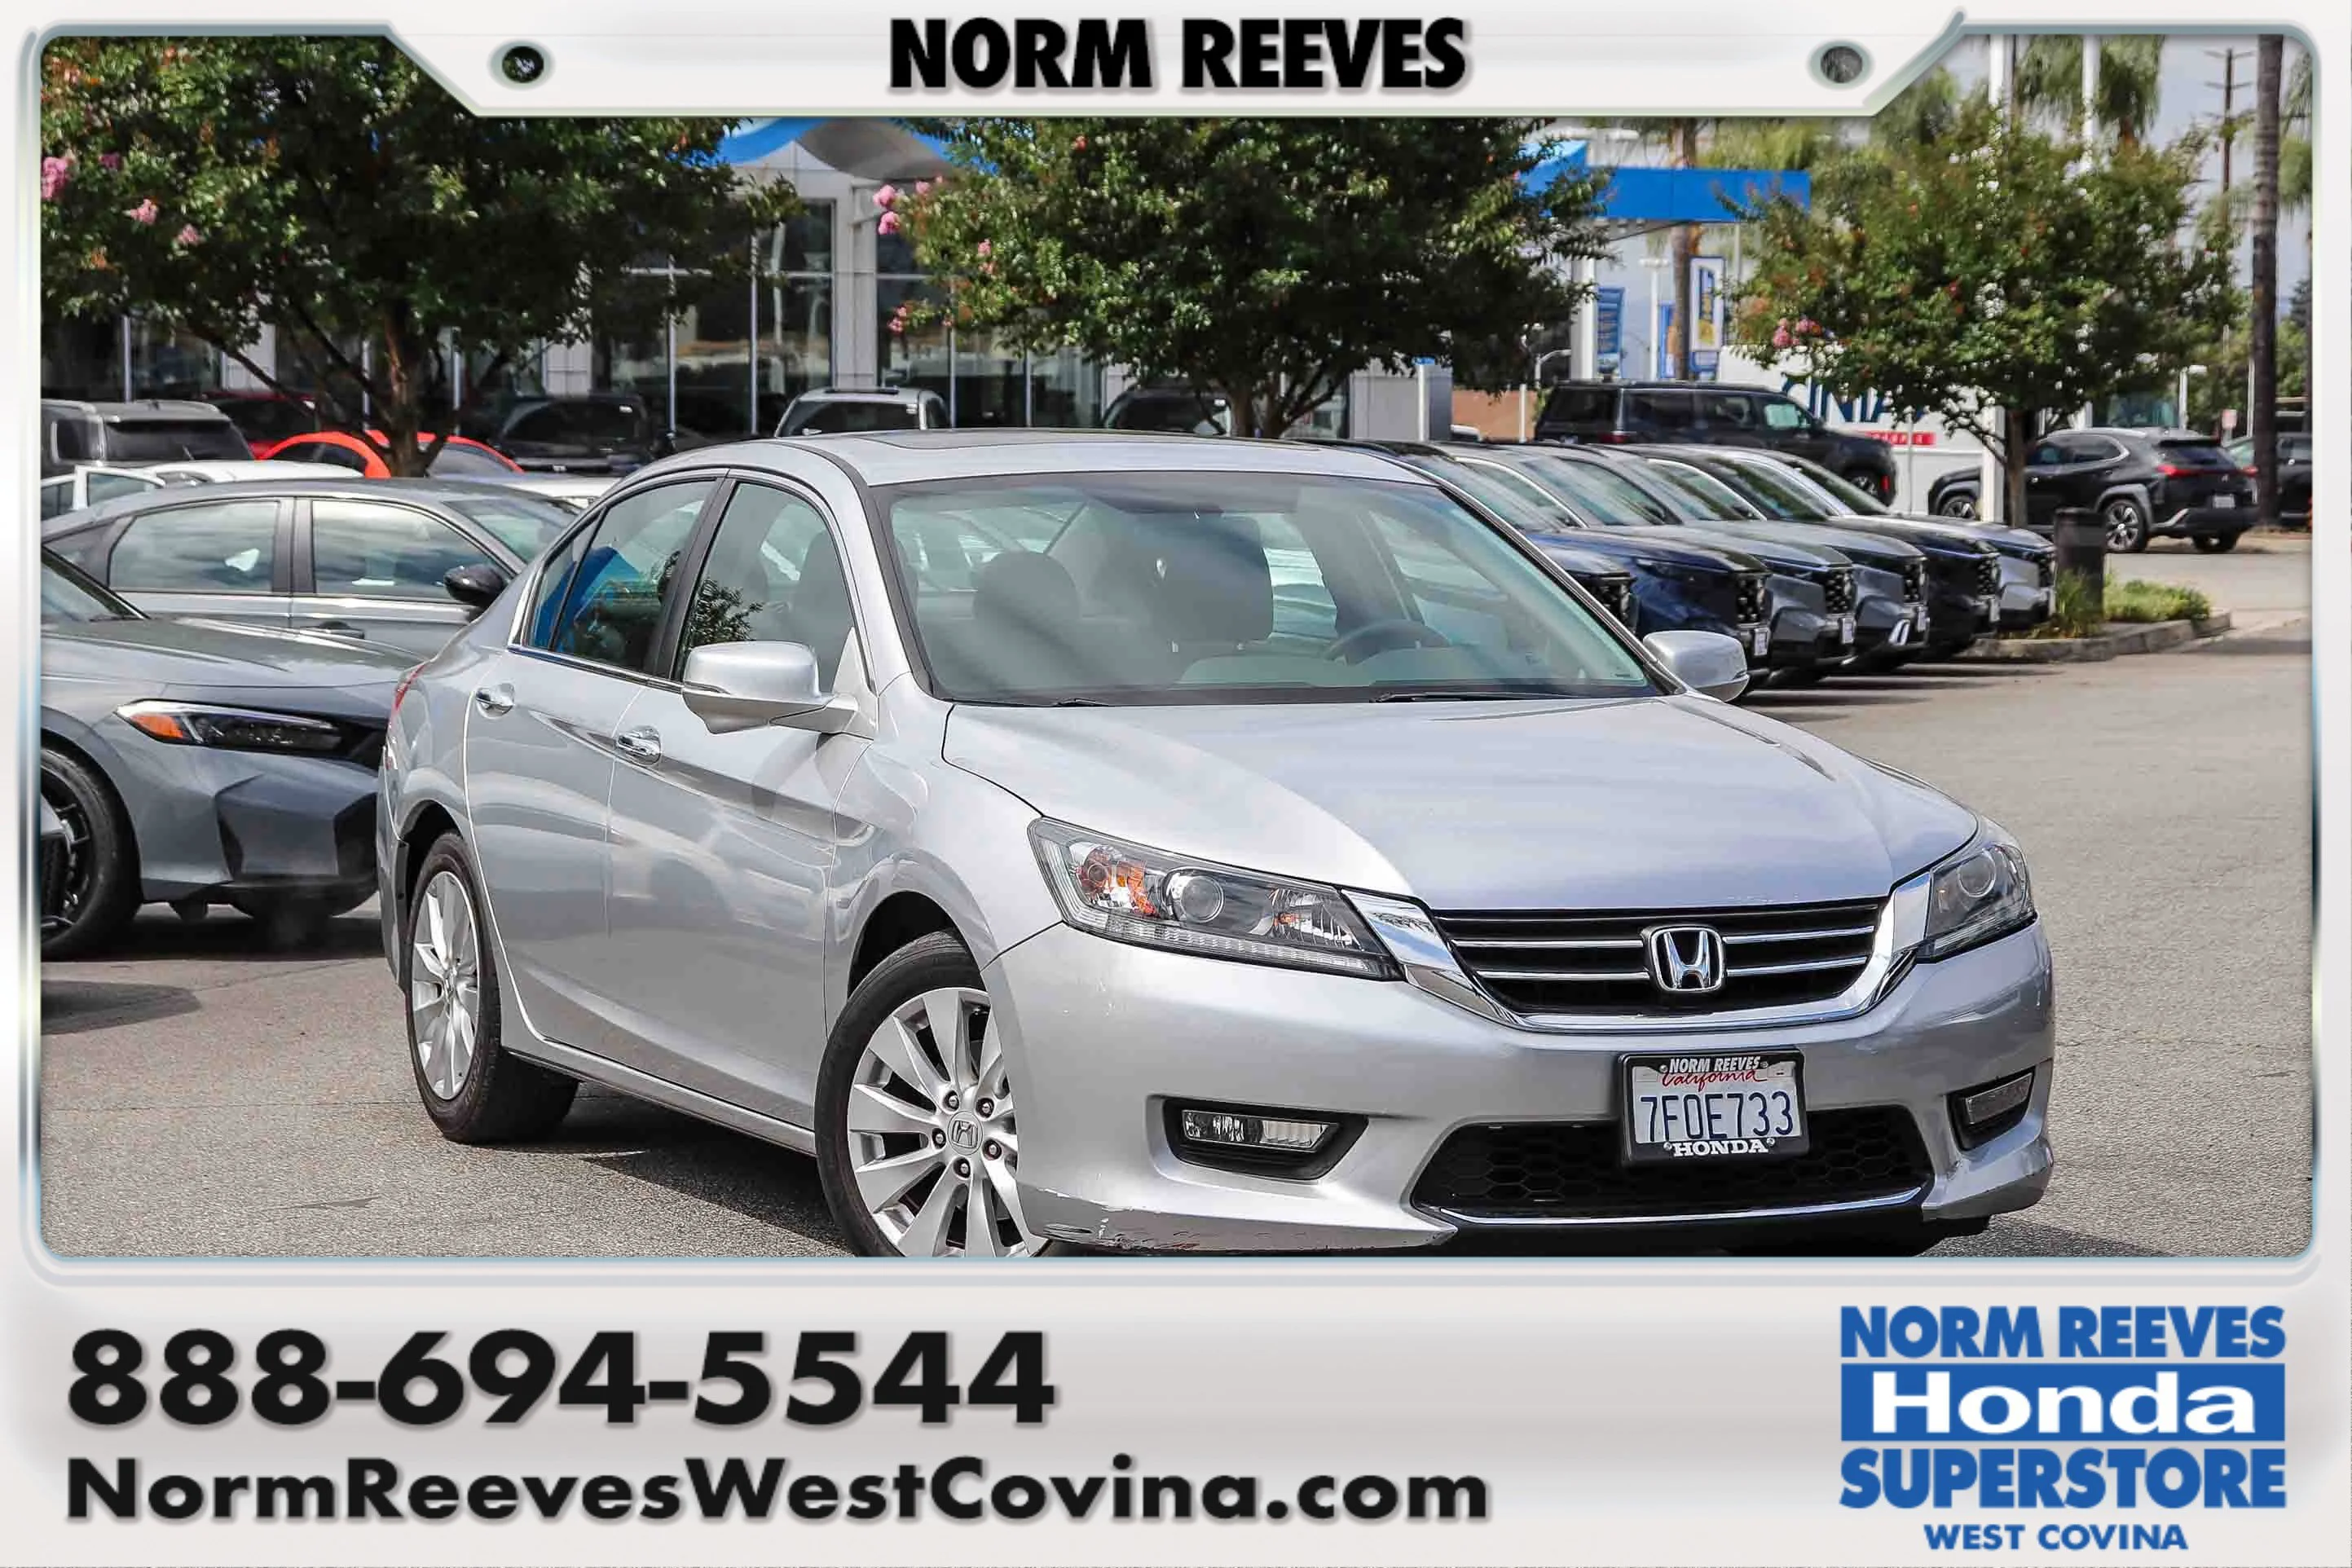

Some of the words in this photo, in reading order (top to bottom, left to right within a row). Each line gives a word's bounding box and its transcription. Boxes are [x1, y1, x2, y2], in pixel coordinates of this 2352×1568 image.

[1669, 1057, 1711, 1073] NORM
[1713, 1055, 1761, 1072] REEVES
[1661, 1069, 1767, 1091] California
[1640, 1090, 1794, 1143] 7FOE733
[1672, 1139, 1769, 1157] HONDA
